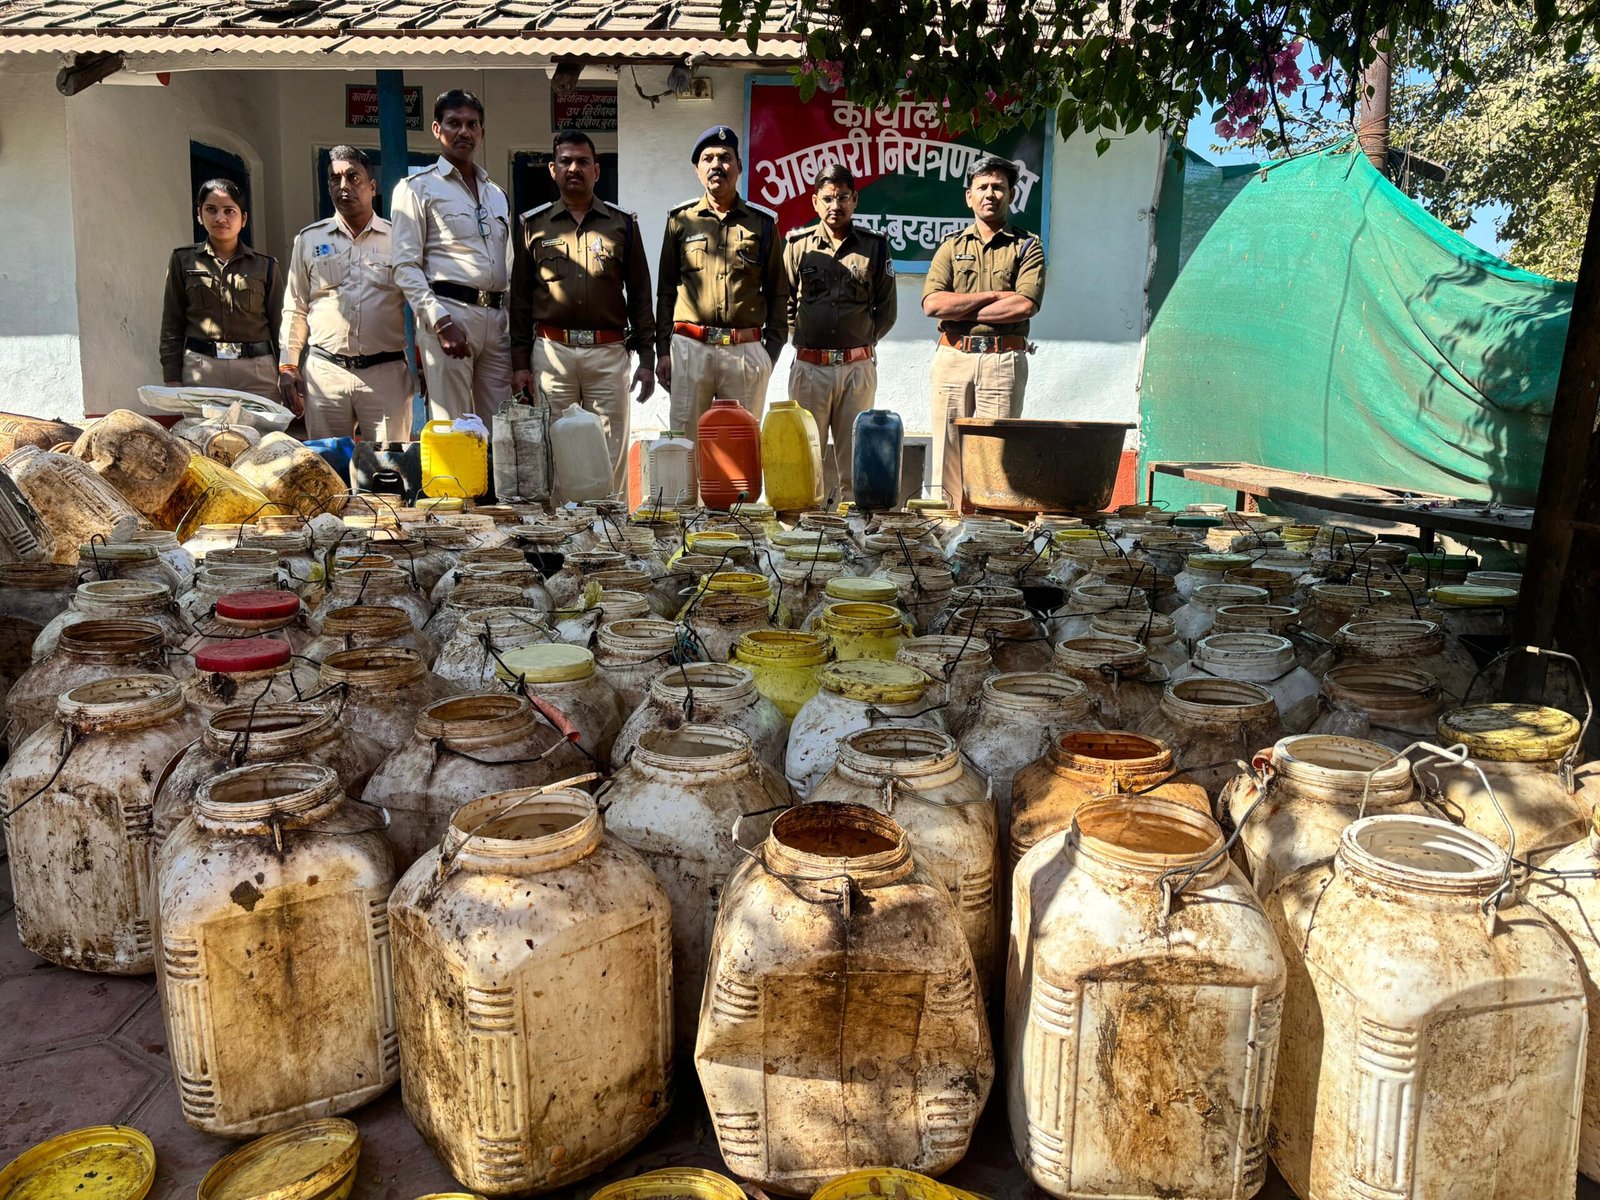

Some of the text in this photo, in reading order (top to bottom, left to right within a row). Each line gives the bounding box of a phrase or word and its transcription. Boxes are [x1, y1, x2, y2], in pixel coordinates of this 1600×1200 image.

[565, 107, 580, 117] उप
[832, 88, 941, 129] कार्याल
[755, 127, 872, 205] आबकारी
[875, 129, 981, 189] नियंत्रण
